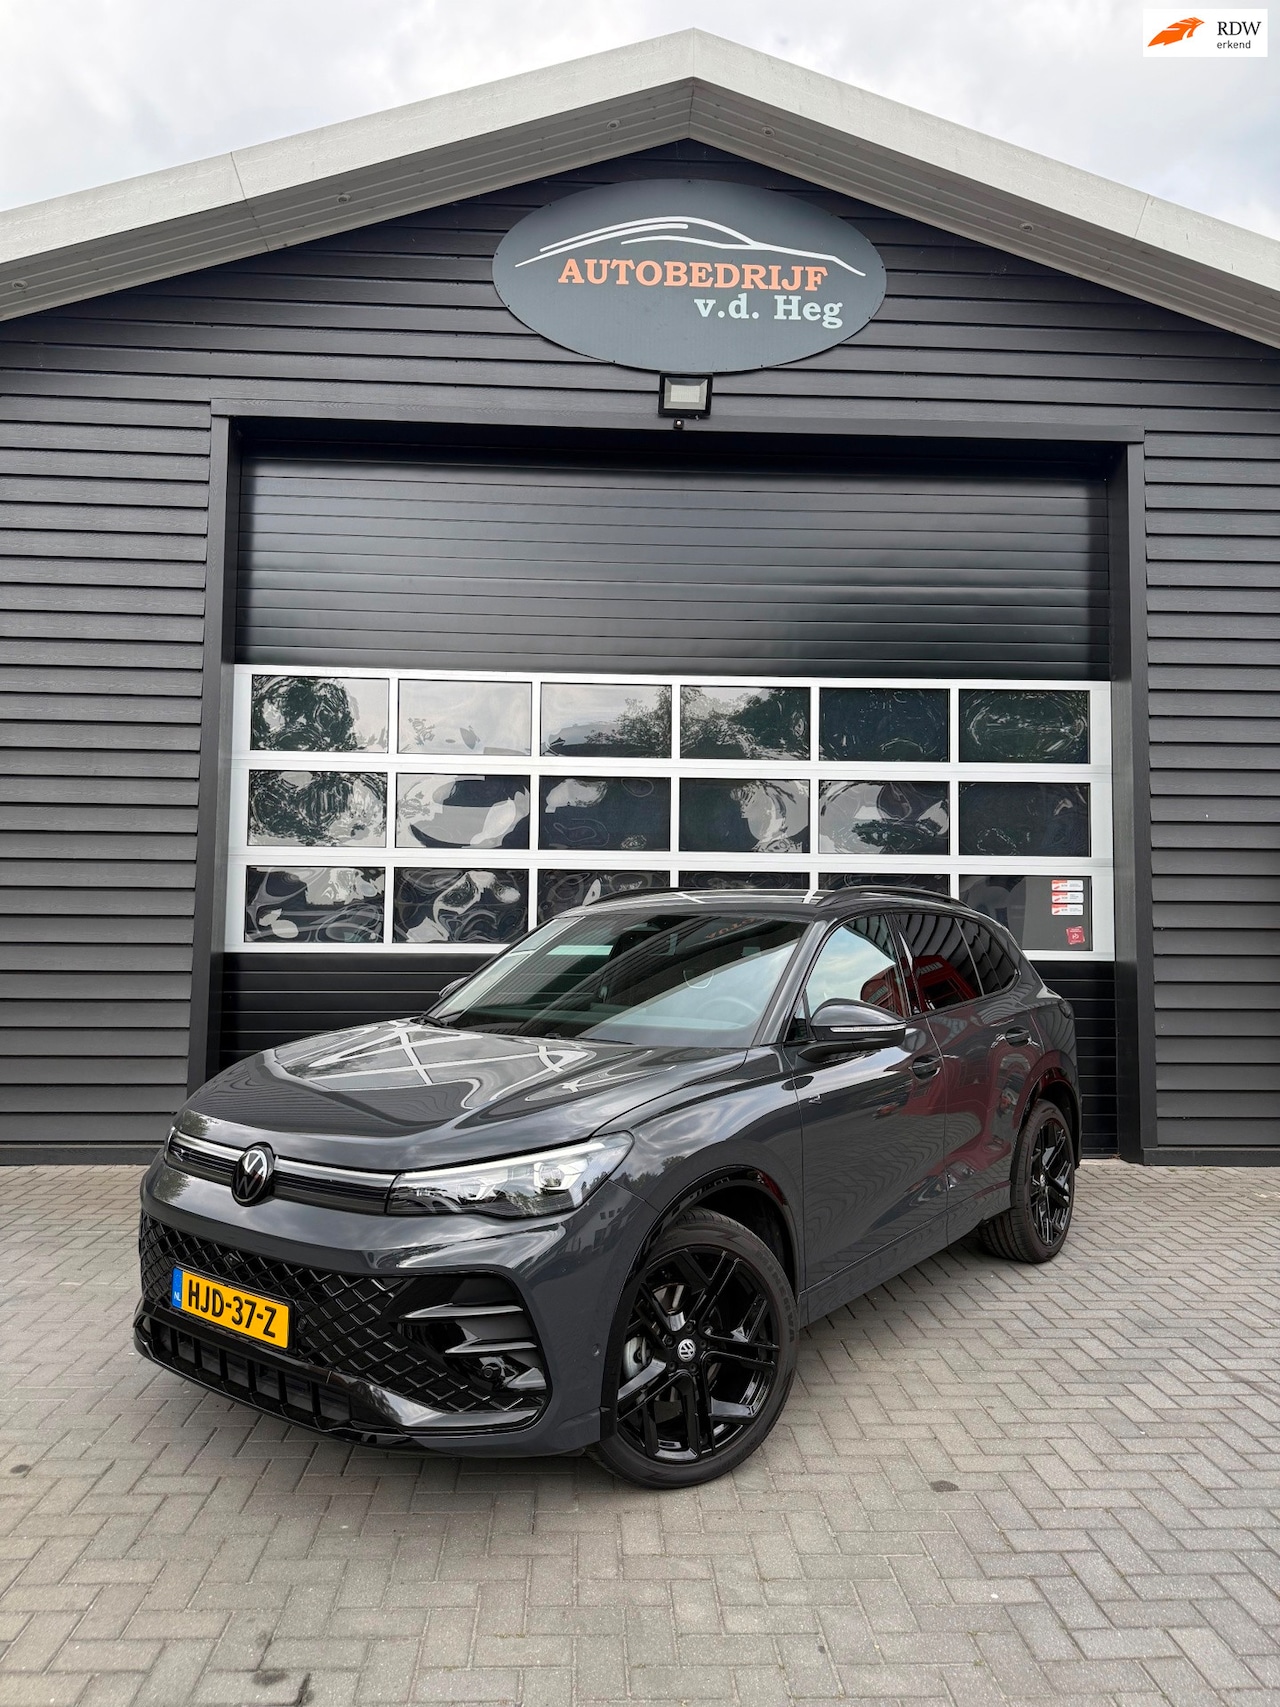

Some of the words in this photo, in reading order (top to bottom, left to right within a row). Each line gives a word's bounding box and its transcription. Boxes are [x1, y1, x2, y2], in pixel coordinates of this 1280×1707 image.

[557, 258, 829, 292] AUTOBEDRIJF
[694, 292, 760, 320] v.d.
[773, 294, 844, 329] Heg
[173, 1290, 182, 1302] NL
[187, 1279, 278, 1339] HJD-37-Z
